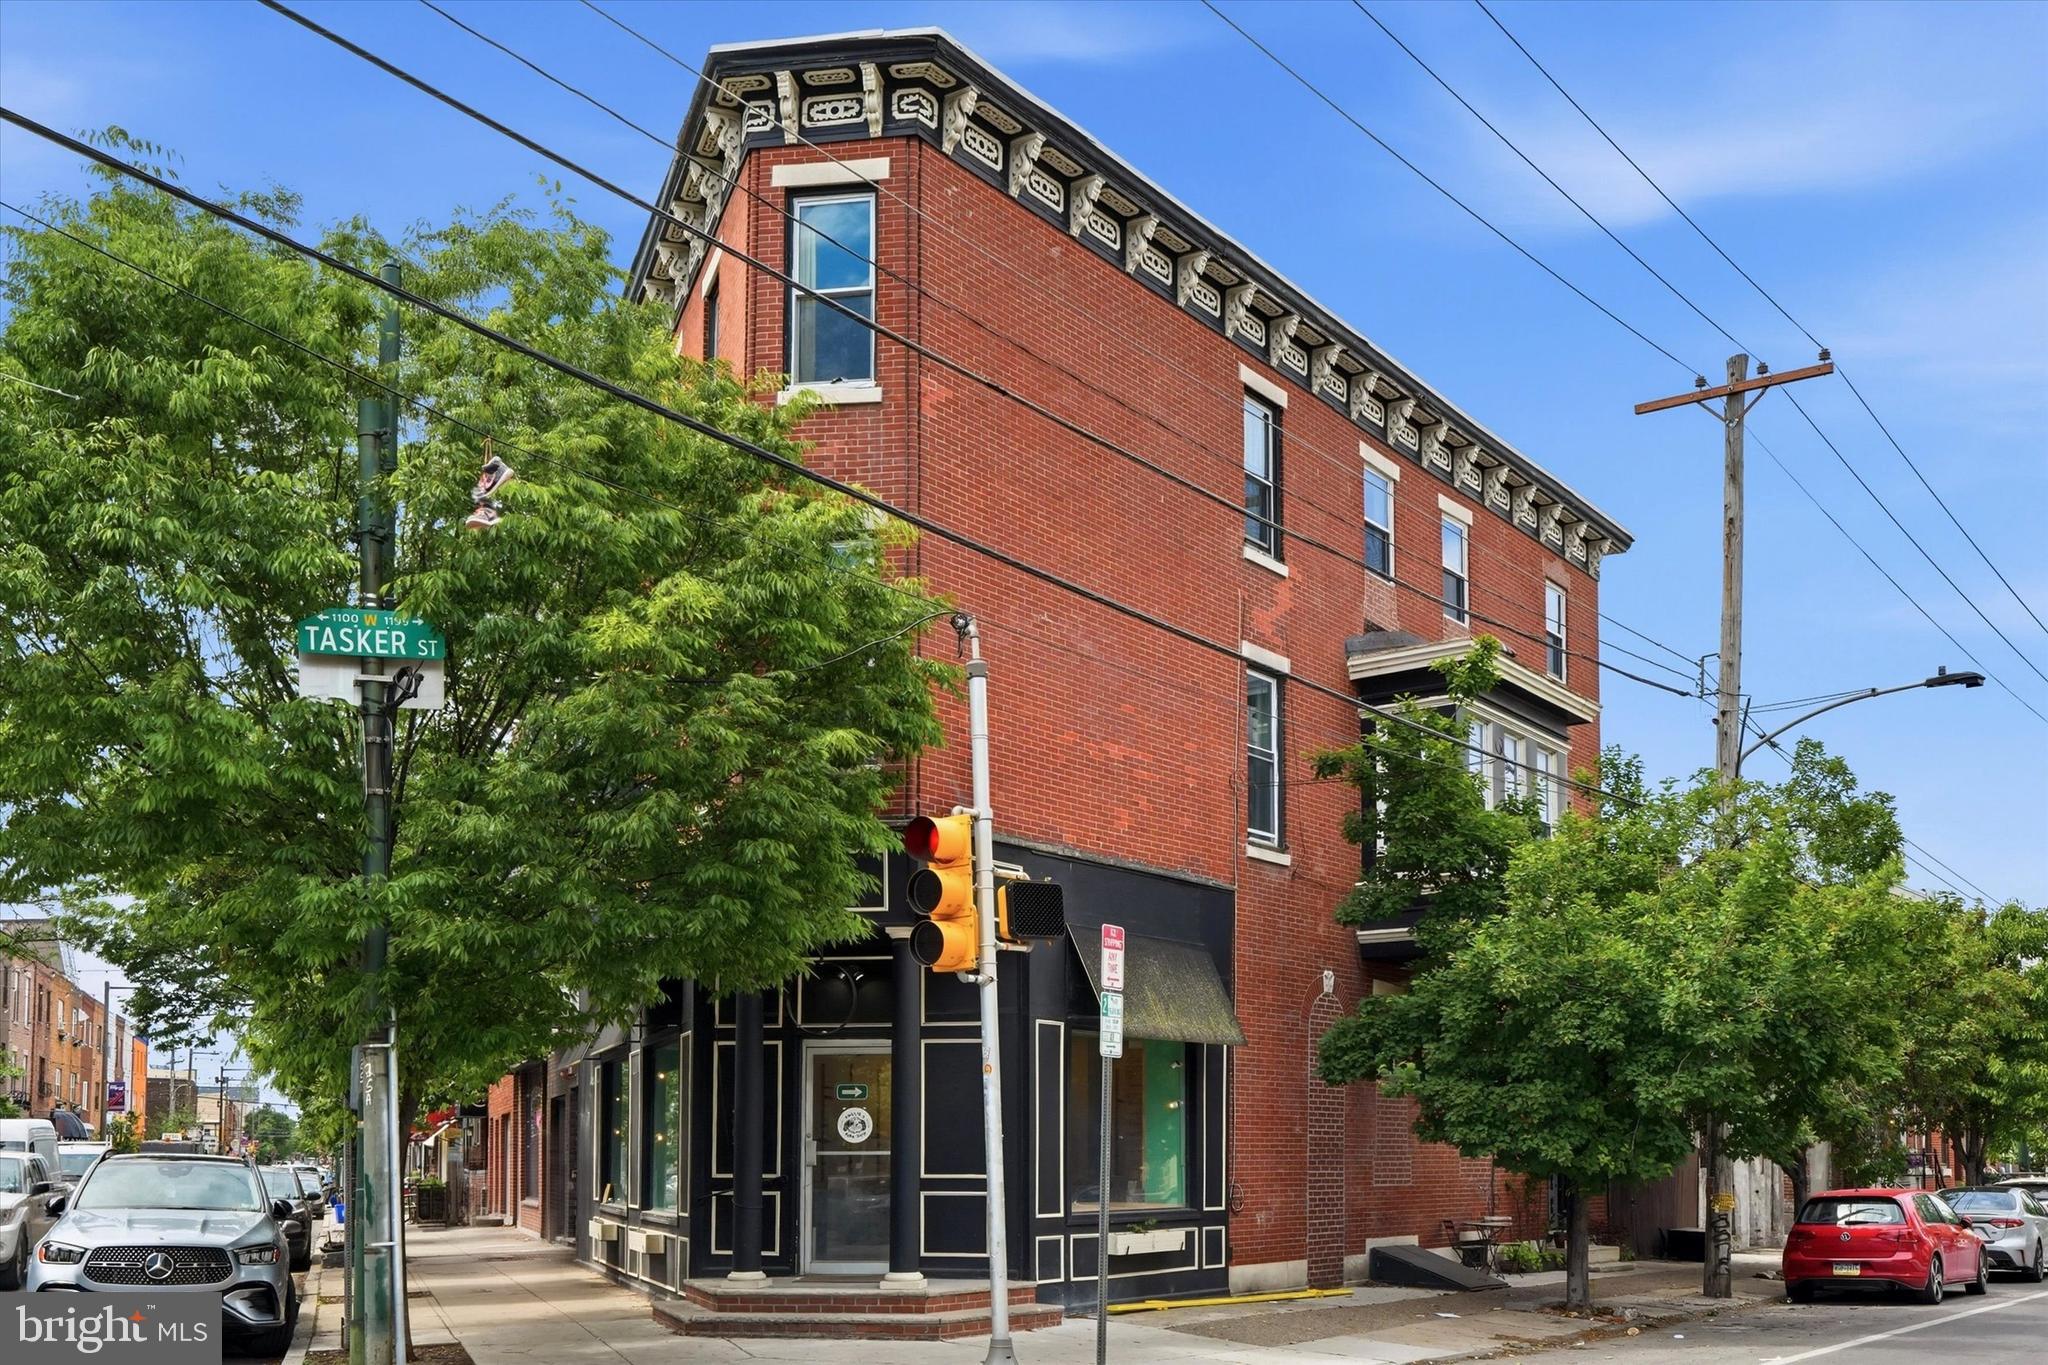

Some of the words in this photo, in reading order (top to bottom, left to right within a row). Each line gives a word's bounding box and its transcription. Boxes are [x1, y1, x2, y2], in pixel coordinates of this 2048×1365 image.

[332, 613, 359, 624] 1100
[363, 614, 378, 626] W
[304, 625, 406, 655] TASKER
[417, 640, 438, 656] ST
